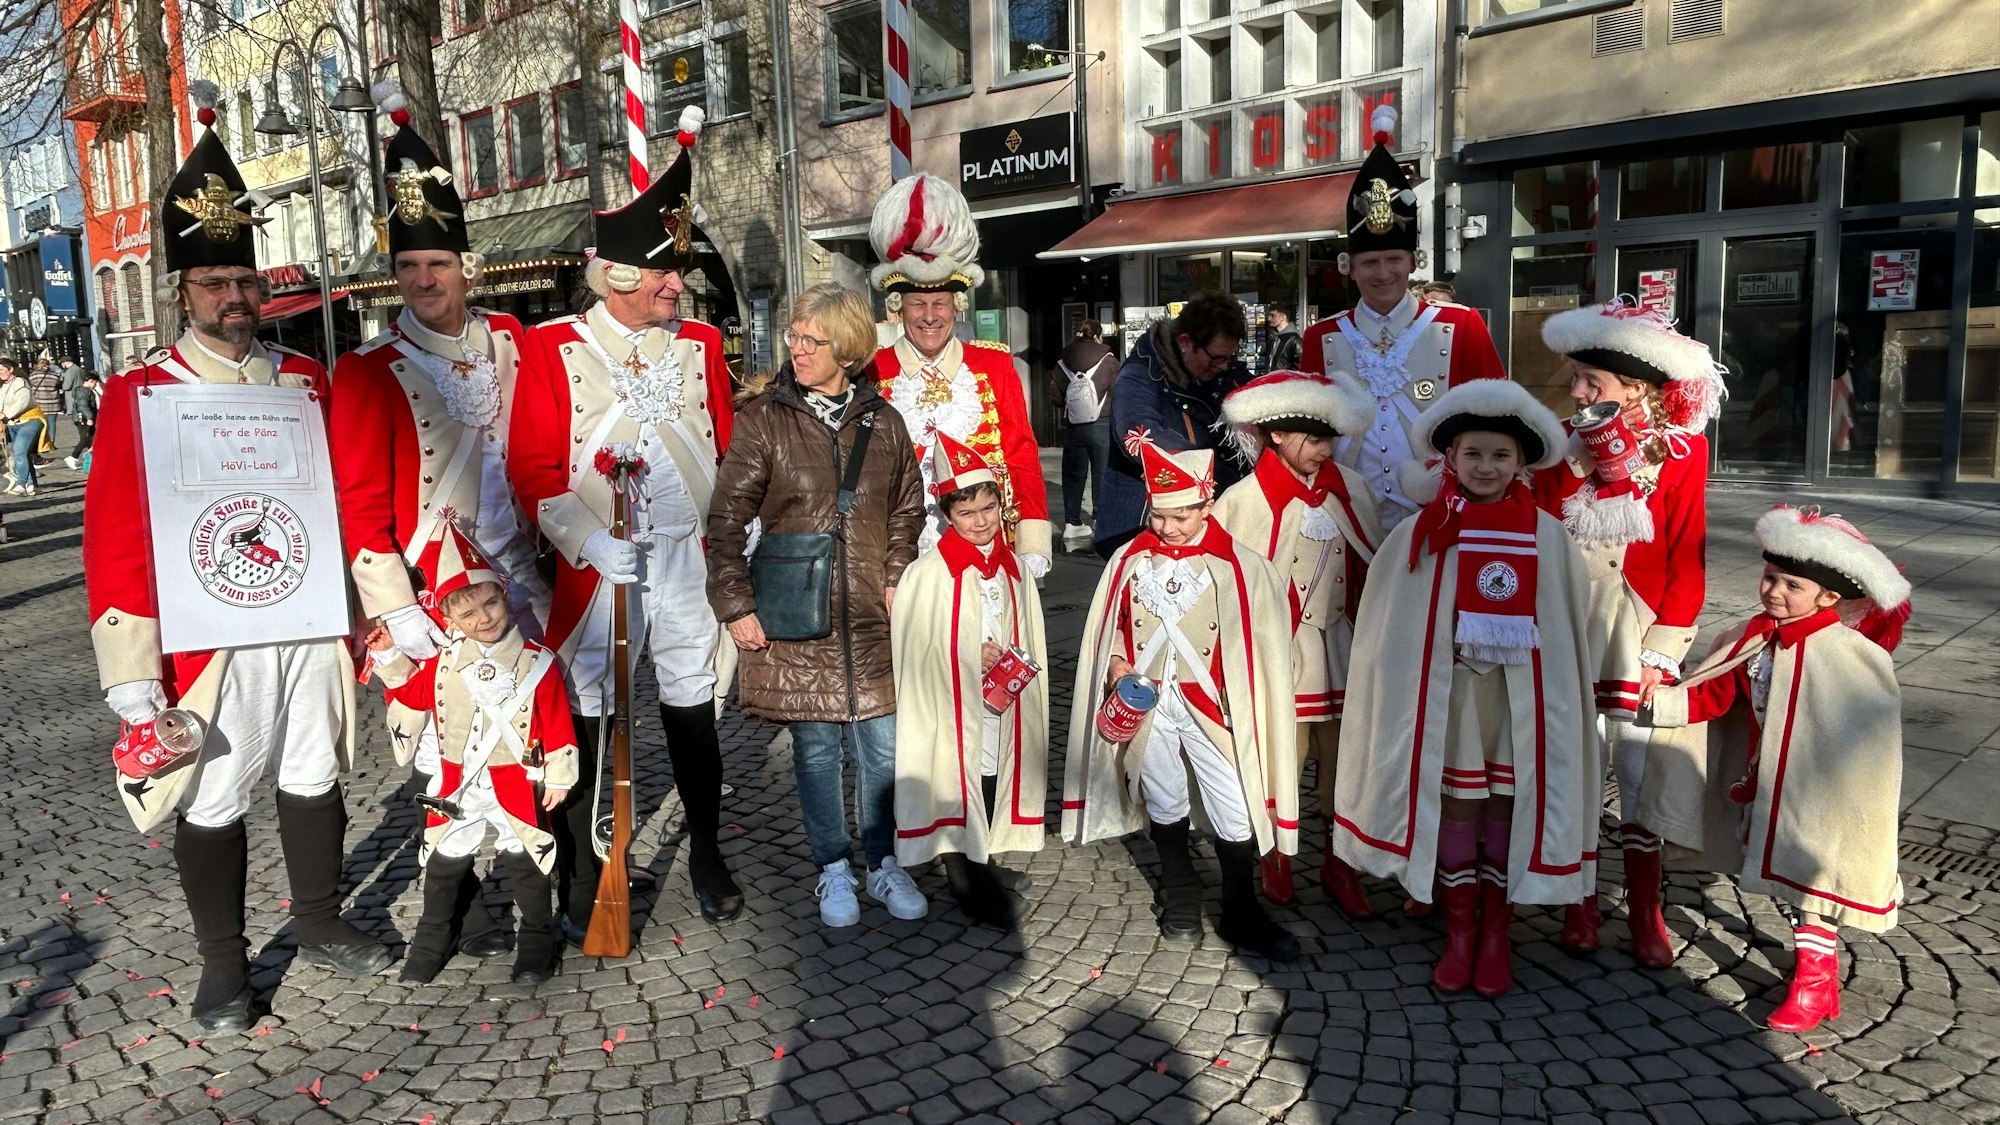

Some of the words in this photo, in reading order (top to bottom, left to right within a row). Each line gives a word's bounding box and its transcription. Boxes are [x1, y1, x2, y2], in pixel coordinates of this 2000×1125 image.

[1153, 91, 1396, 183] KIOSK
[963, 147, 1069, 182] PLATINUM
[45, 270, 74, 281] Gaffel
[213, 428, 232, 437] För
[237, 427, 250, 437] de
[254, 427, 278, 437] Pänz
[240, 446, 257, 454] em
[220, 460, 278, 470] HöVi-Land
[247, 589, 272, 602] 1823
